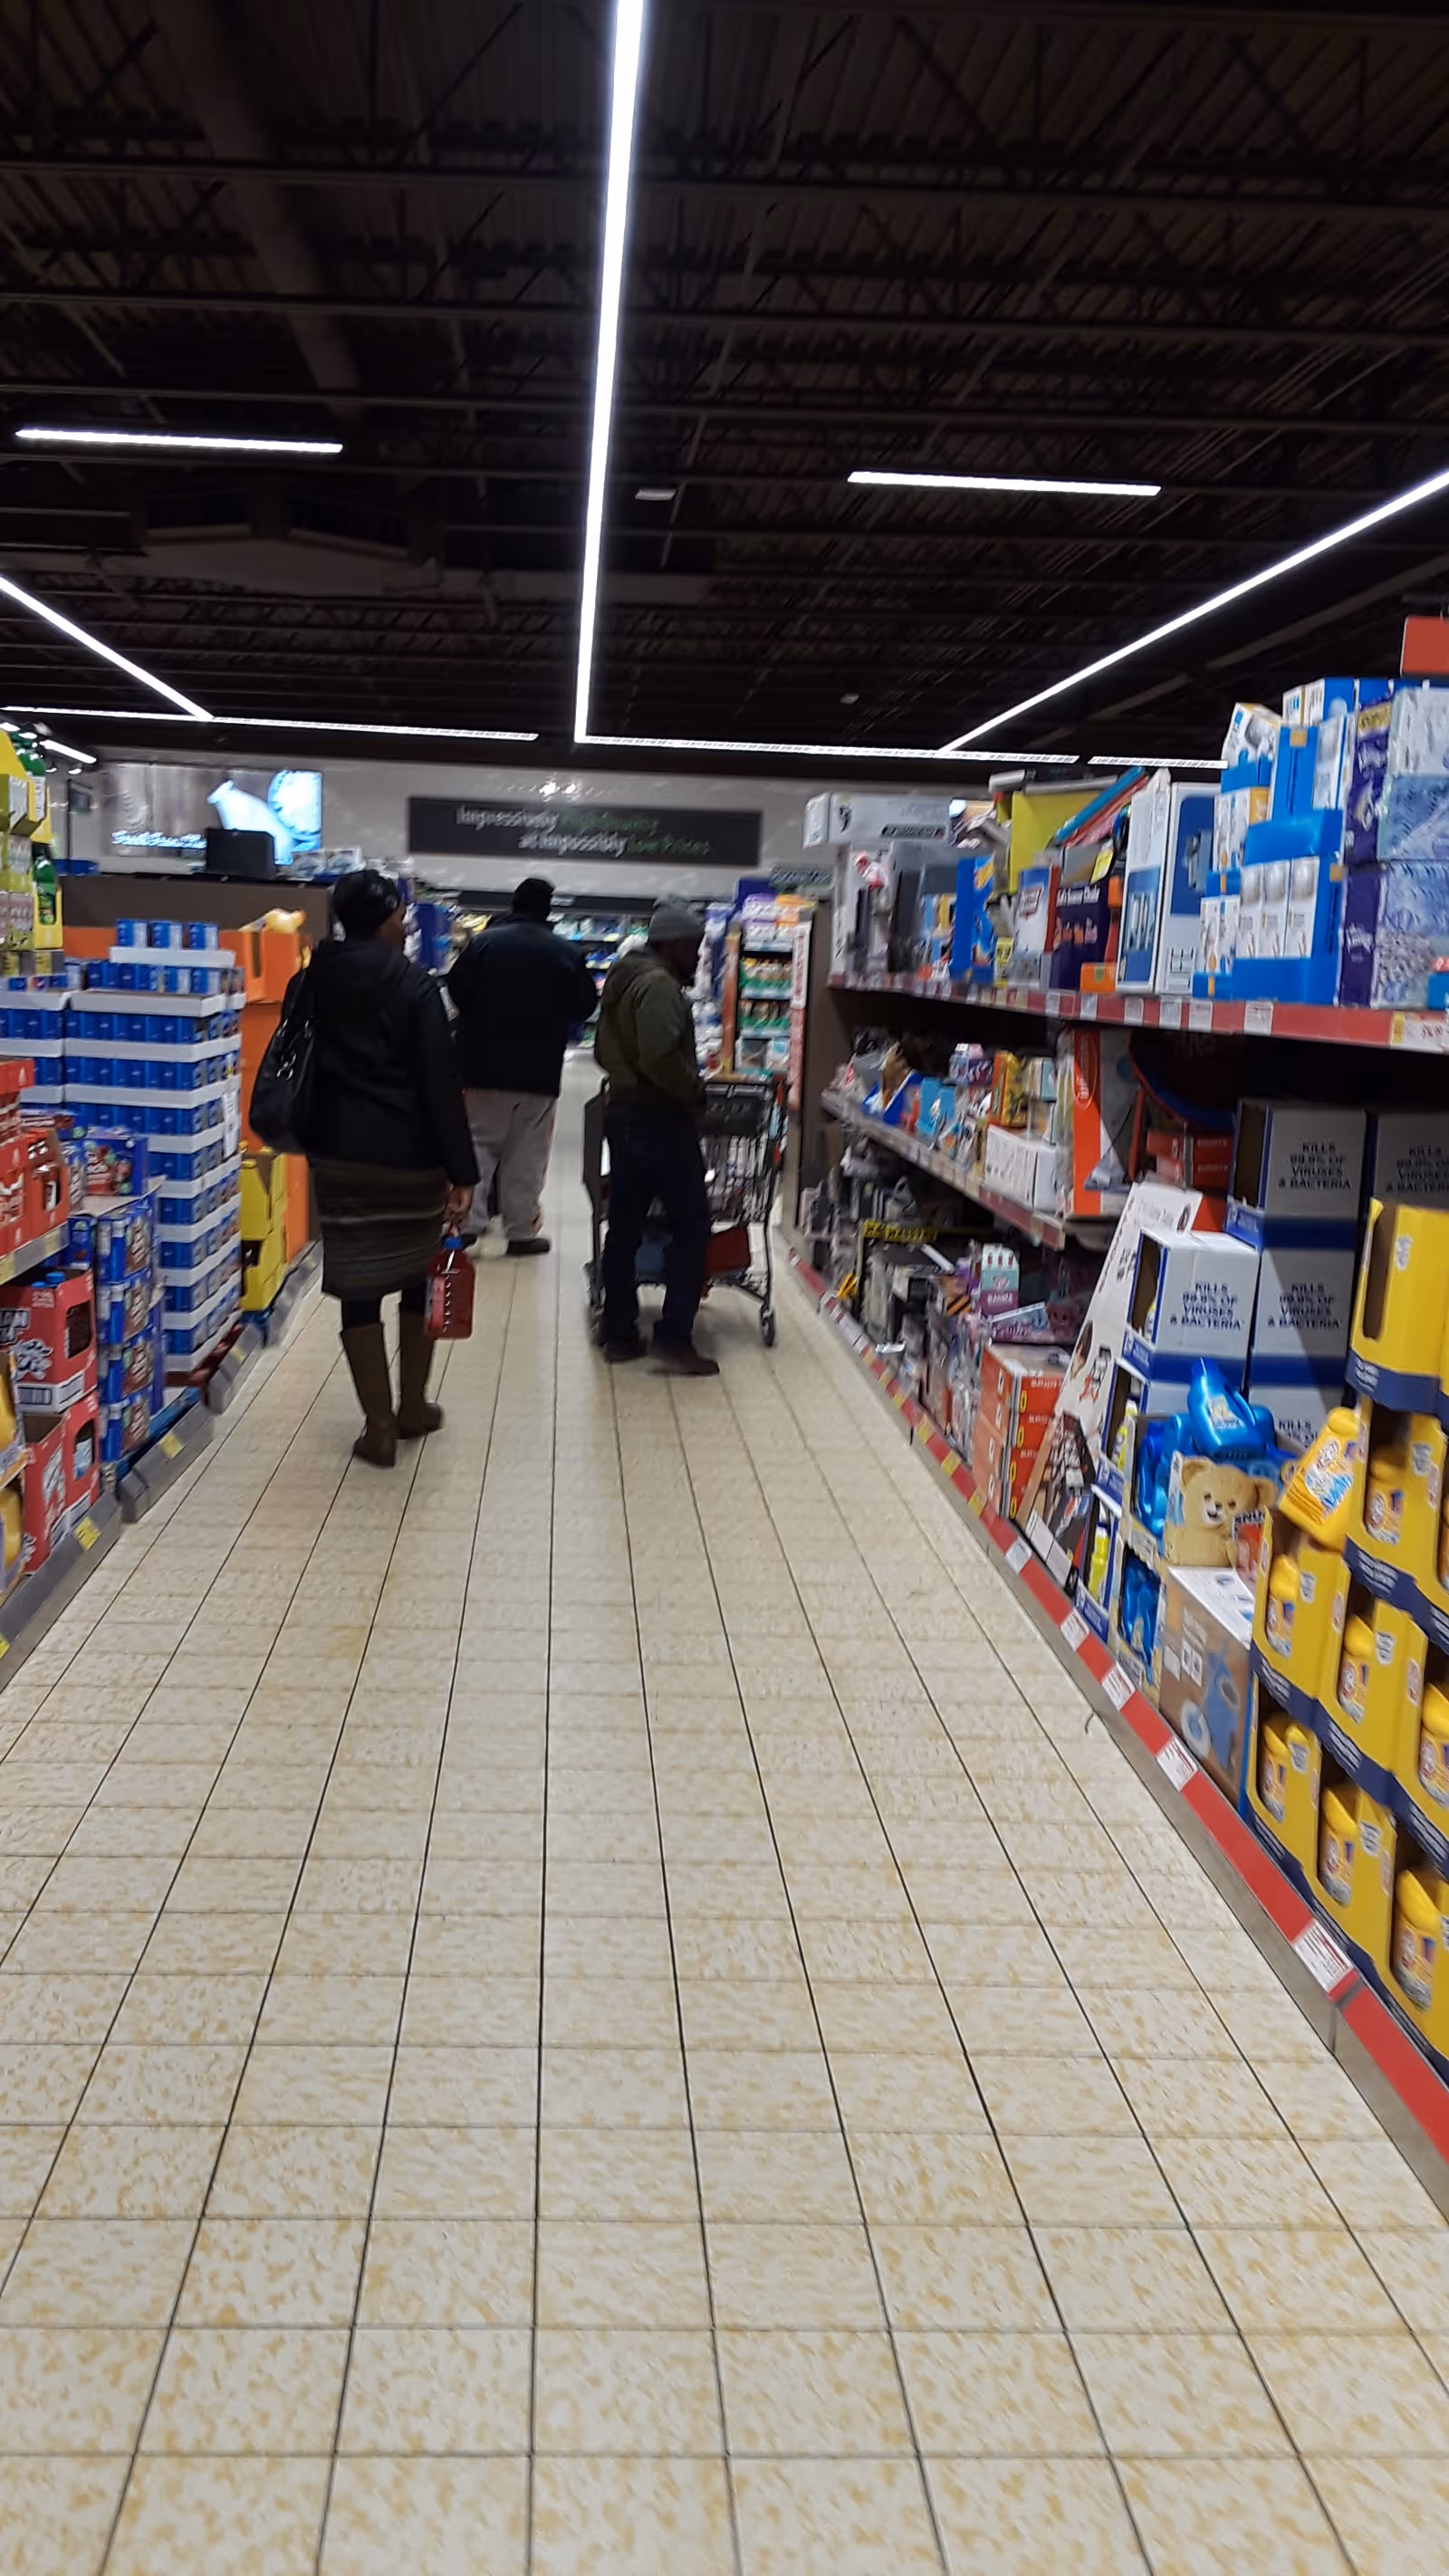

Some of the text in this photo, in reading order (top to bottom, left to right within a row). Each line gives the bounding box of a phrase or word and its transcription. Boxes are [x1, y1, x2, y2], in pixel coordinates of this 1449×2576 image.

[1301, 1142, 1337, 1154] KILLS
[1329, 1155, 1346, 1165] OF
[1291, 1166, 1343, 1177] VIRUSES
[1279, 1178, 1351, 1190] & BACTERIA
[1195, 1283, 1228, 1293] KILLS
[1291, 1283, 1325, 1293] KILLS
[1221, 1295, 1237, 1306] OF
[1318, 1295, 1335, 1305] OF
[1184, 1304, 1233, 1317] VIRUSES
[1281, 1305, 1332, 1317] VIRUSES
[1170, 1315, 1241, 1330] & BACTERIA
[1268, 1316, 1340, 1329] & BACTERIA
[1279, 1419, 1311, 1431] KILLS
